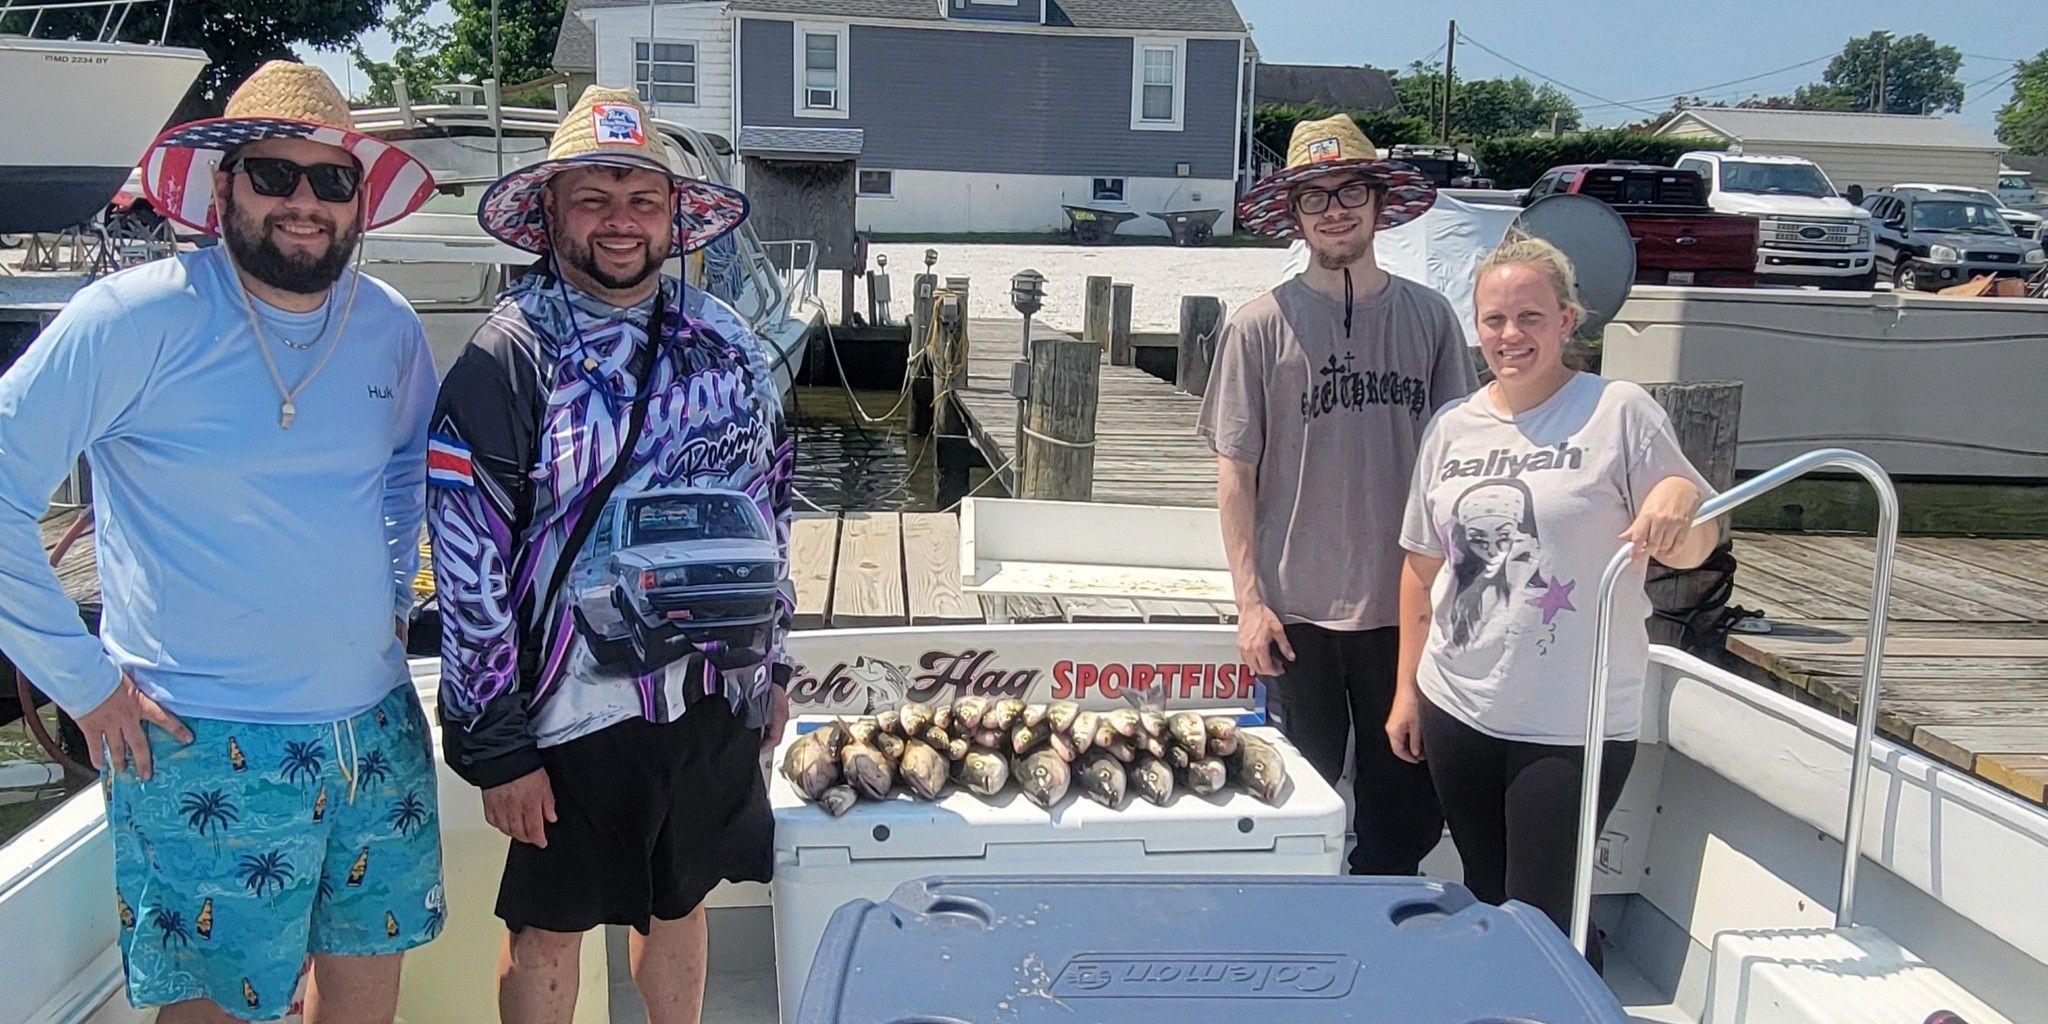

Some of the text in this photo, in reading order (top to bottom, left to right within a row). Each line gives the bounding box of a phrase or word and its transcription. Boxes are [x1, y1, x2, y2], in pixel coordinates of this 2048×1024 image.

[53, 55, 69, 63] MD
[367, 384, 394, 399] Huk
[1441, 442, 1583, 482] aaliyah
[906, 649, 1042, 703] Hag
[1121, 962, 1337, 992] Coleman
